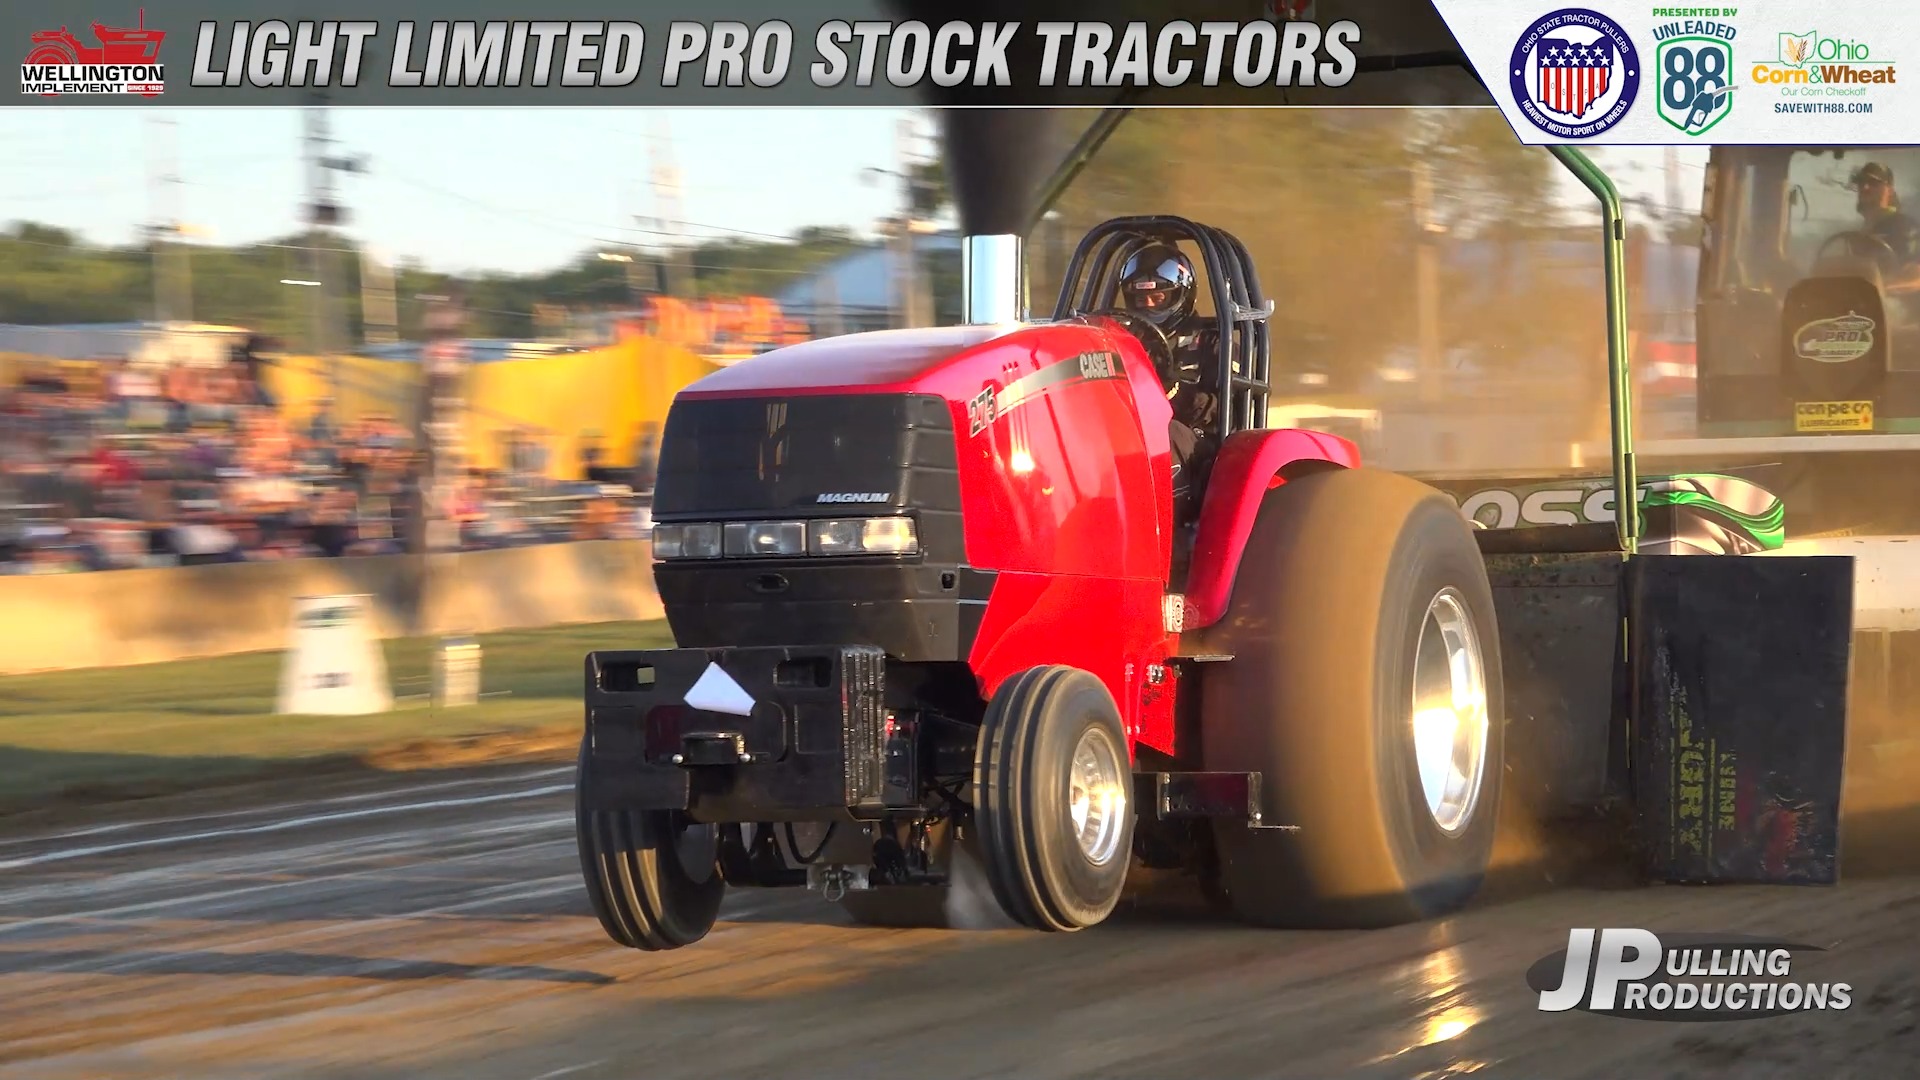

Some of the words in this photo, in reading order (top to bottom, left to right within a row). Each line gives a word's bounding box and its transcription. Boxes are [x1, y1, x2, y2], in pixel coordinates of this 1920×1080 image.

[1079, 352, 1109, 379] CASE
[967, 384, 999, 438] 275
[816, 492, 890, 503] MAGNUM
